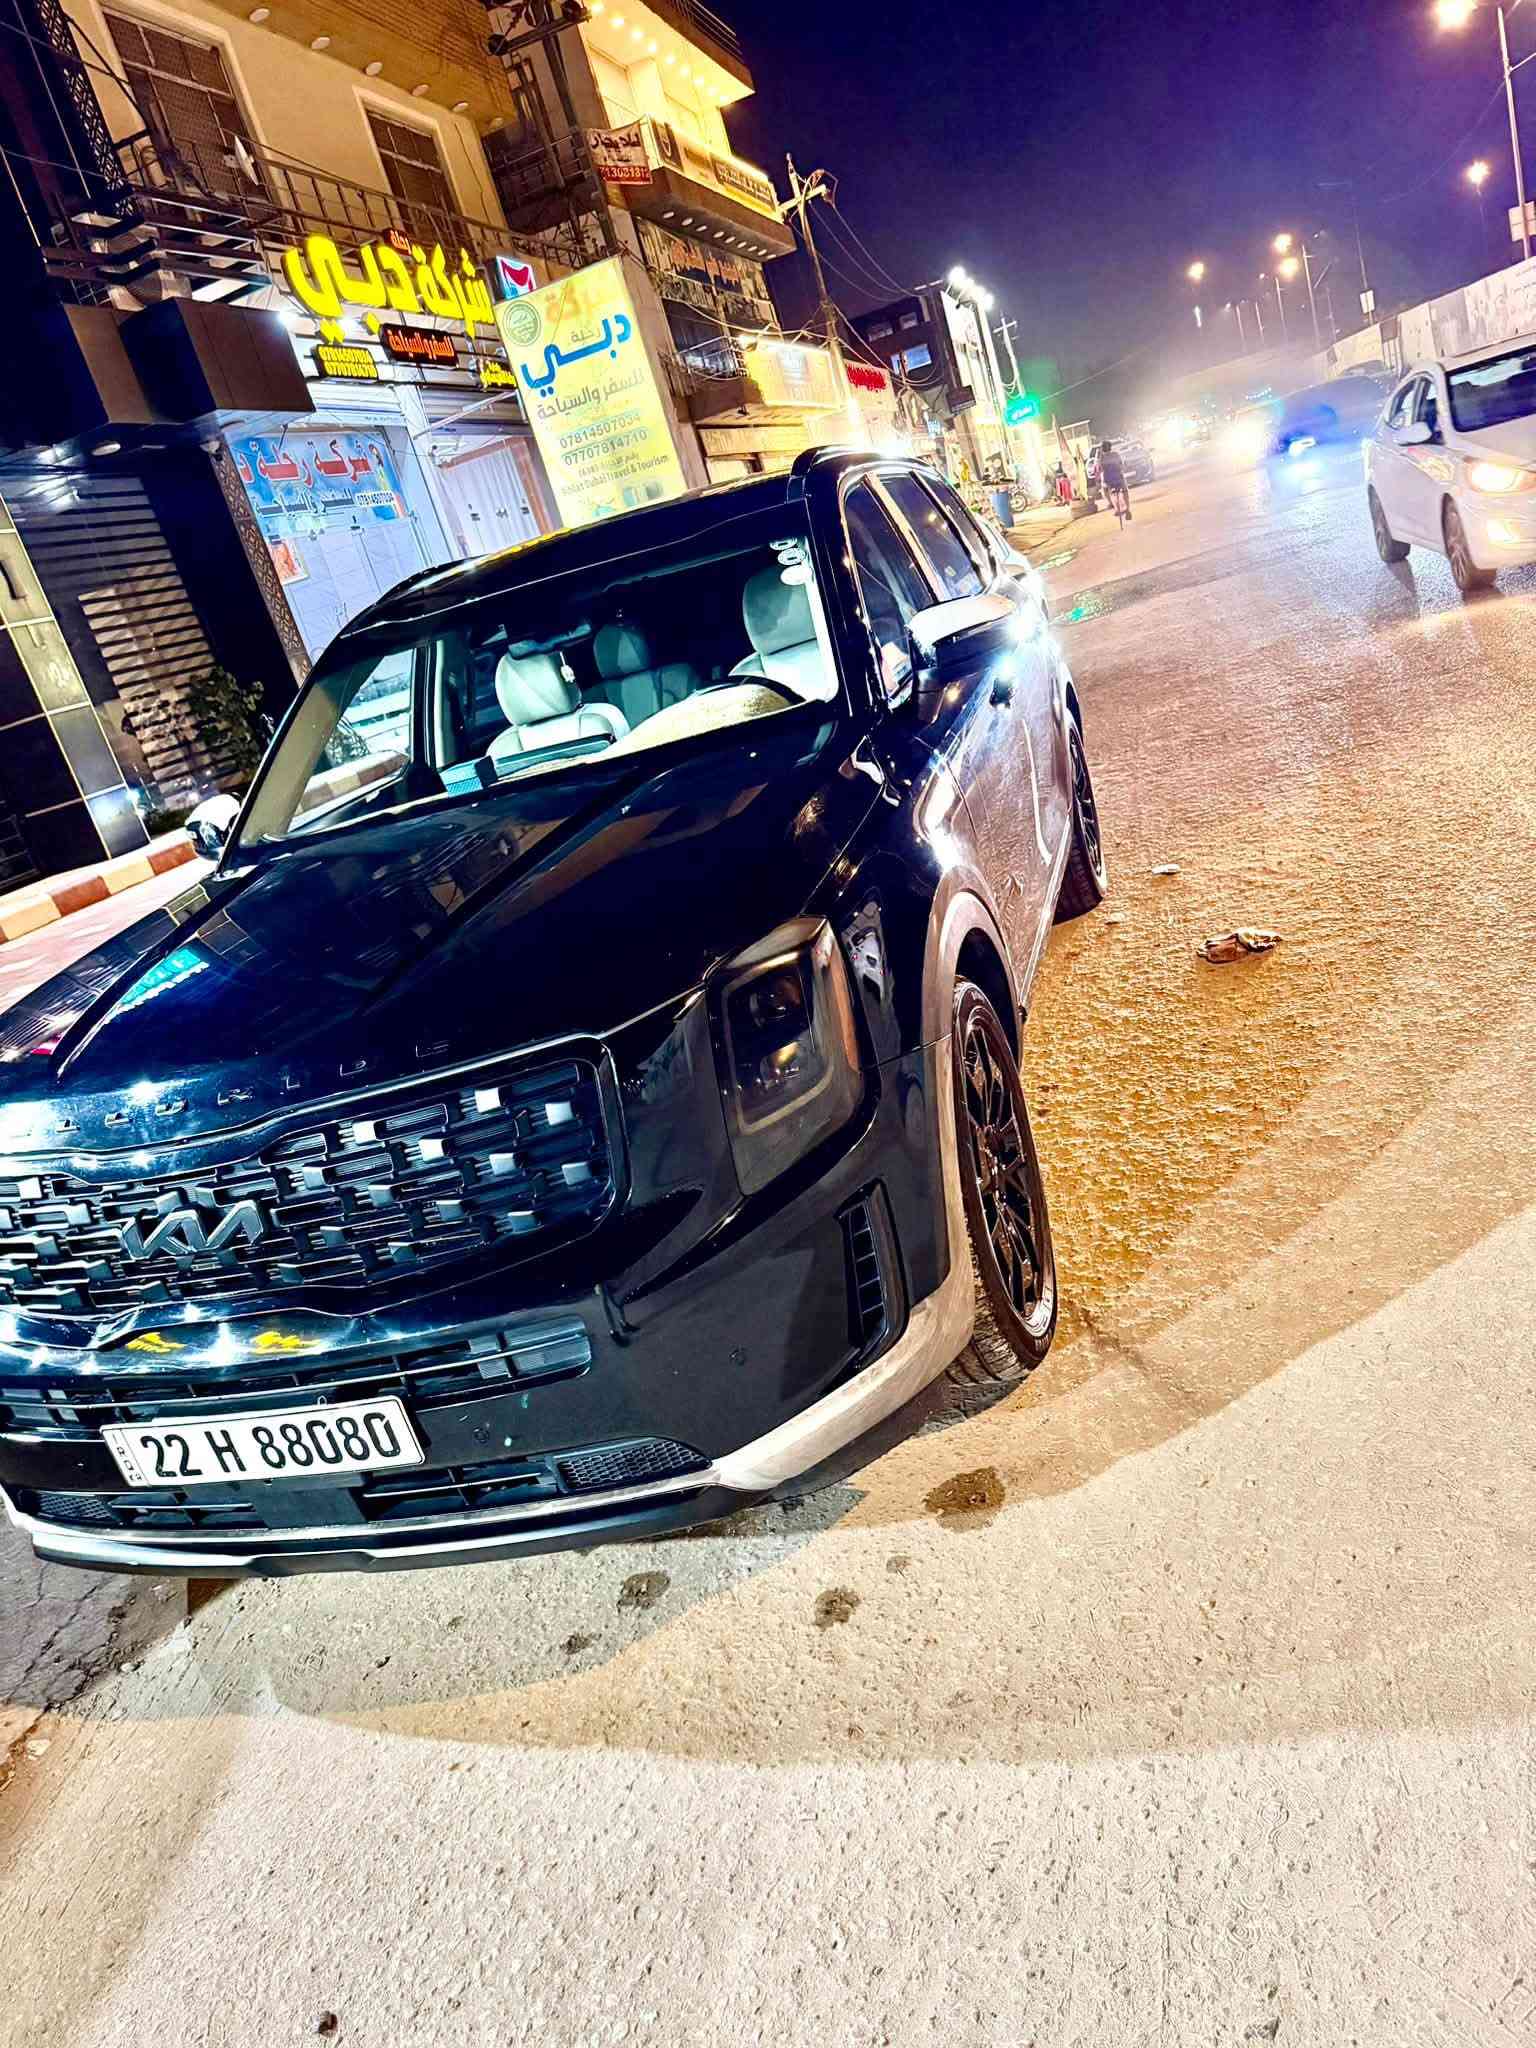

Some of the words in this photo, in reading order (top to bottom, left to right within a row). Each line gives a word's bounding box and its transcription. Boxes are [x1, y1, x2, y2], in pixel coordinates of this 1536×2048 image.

[284, 235, 422, 344] دبي
[411, 243, 496, 339] شركة
[520, 313, 632, 398] دبي
[570, 327, 601, 343] رحلة
[536, 386, 602, 421] والسياحة
[602, 367, 647, 400] للسفر
[249, 438, 314, 489] رحلة
[304, 439, 380, 484] شركة
[563, 429, 648, 467] 07707814710
[119, 1200, 264, 1260] KIA
[140, 1434, 203, 1478] 22
[204, 1429, 247, 1473] H
[251, 1412, 401, 1470] 88080
